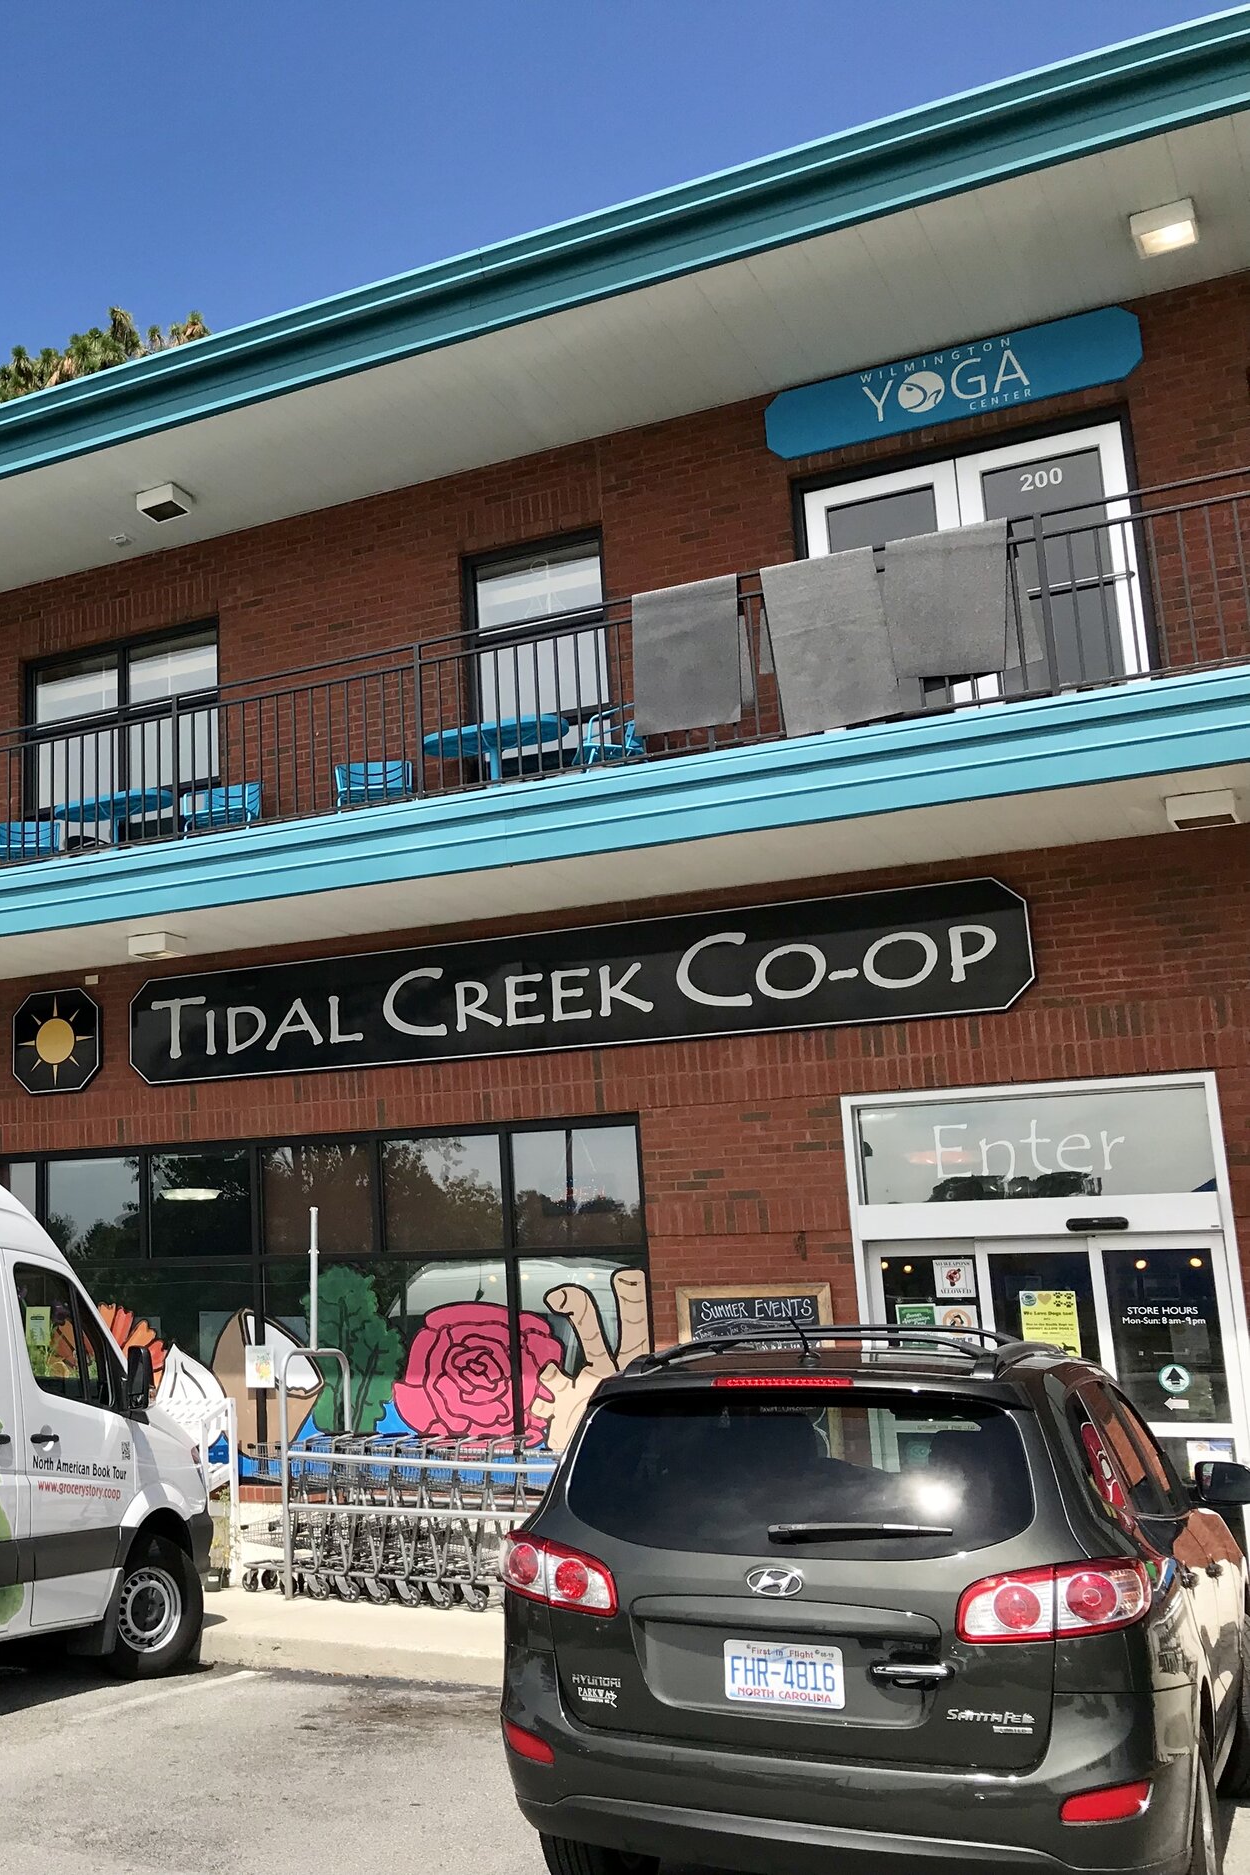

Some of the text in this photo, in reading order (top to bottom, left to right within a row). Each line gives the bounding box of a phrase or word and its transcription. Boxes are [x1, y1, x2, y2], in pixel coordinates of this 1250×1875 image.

[860, 337, 1011, 384] WILMINGTON
[861, 349, 1031, 422] YOGA
[969, 388, 1032, 411] CENTER
[1019, 467, 1063, 492] 200
[150, 922, 998, 1061] TIDAL CREEK CO-OP
[932, 1119, 1126, 1184] Enter
[701, 1298, 813, 1322] SUMMER EVENTS
[1122, 1316, 1161, 1325] Mon-Sun:
[1127, 1306, 1199, 1315] STORE HOURS
[32, 1455, 127, 1481] North American Book Tour
[37, 1480, 122, 1501] www.grocerystory.coop
[751, 1646, 771, 1655] First
[789, 1649, 814, 1659] Flight
[572, 1674, 621, 1688] HYUNDAI
[731, 1656, 836, 1692] FHR-4816
[737, 1686, 832, 1703] NORTH CAROLINA
